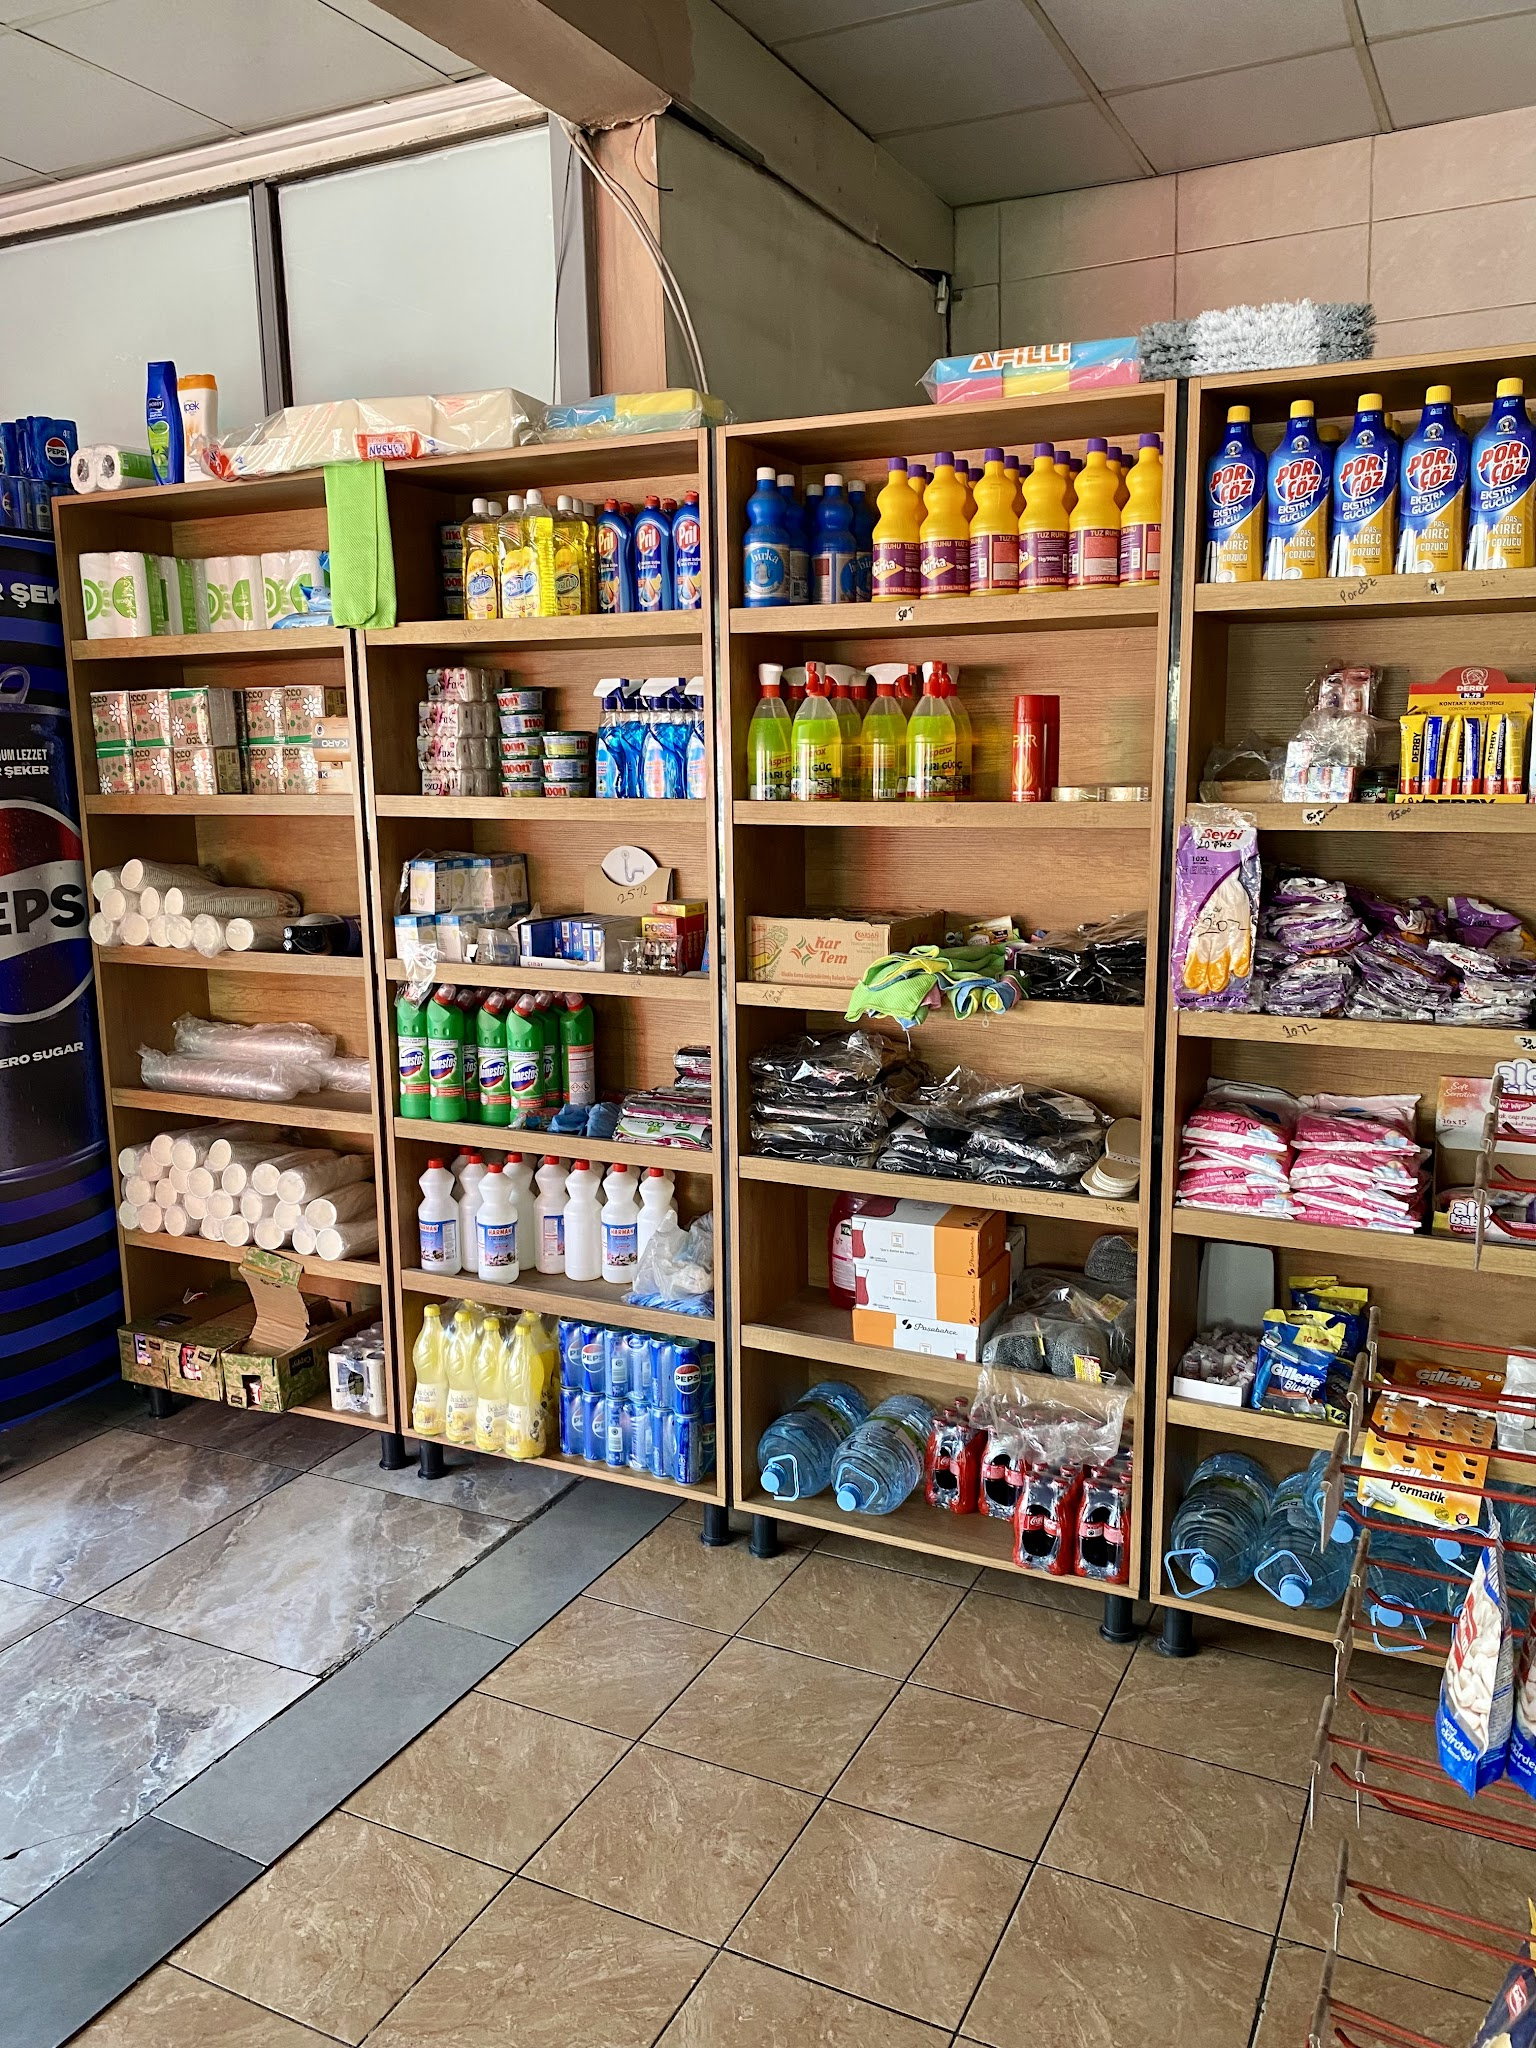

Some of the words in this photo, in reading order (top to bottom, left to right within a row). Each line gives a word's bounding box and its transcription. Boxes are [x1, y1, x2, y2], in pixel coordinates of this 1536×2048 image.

[1407, 448, 1449, 476] POR
[1478, 442, 1523, 471] POR
[1209, 465, 1247, 492] POR
[1274, 459, 1315, 486] POR
[1340, 456, 1378, 483] POR
[1419, 465, 1455, 491] ÇÖZ
[1491, 458, 1528, 486] ÇÖZ
[1221, 480, 1253, 507] ÇÖZ
[1286, 477, 1320, 503] ÇÖZ
[1352, 473, 1384, 498] ÇÖZ
[1480, 485, 1517, 500] EKSTRA
[1278, 500, 1310, 514] EKSTRA
[1342, 496, 1376, 511] EKSTRA
[1410, 490, 1445, 505] EKSTRA
[1212, 505, 1244, 518] EKSTRA
[598, 531, 614, 552] Pril
[639, 527, 656, 549] Pril
[679, 523, 698, 548] Pril
[751, 549, 779, 565] birka
[872, 559, 896, 576] birka
[921, 557, 947, 576] birka
[16, 749, 47, 761] LEZZET
[1412, 732, 1422, 762] DERBY
[1488, 731, 1498, 761] DERBY
[4, 765, 49, 779] ŞEKER
[820, 950, 848, 965] Tem
[32, 1041, 84, 1062] SUGAR
[1451, 1082, 1469, 1091] Soft
[1270, 1363, 1321, 1388] Gillette
[1416, 1369, 1482, 1389] Gillette
[1391, 1481, 1445, 1504] Permatik
